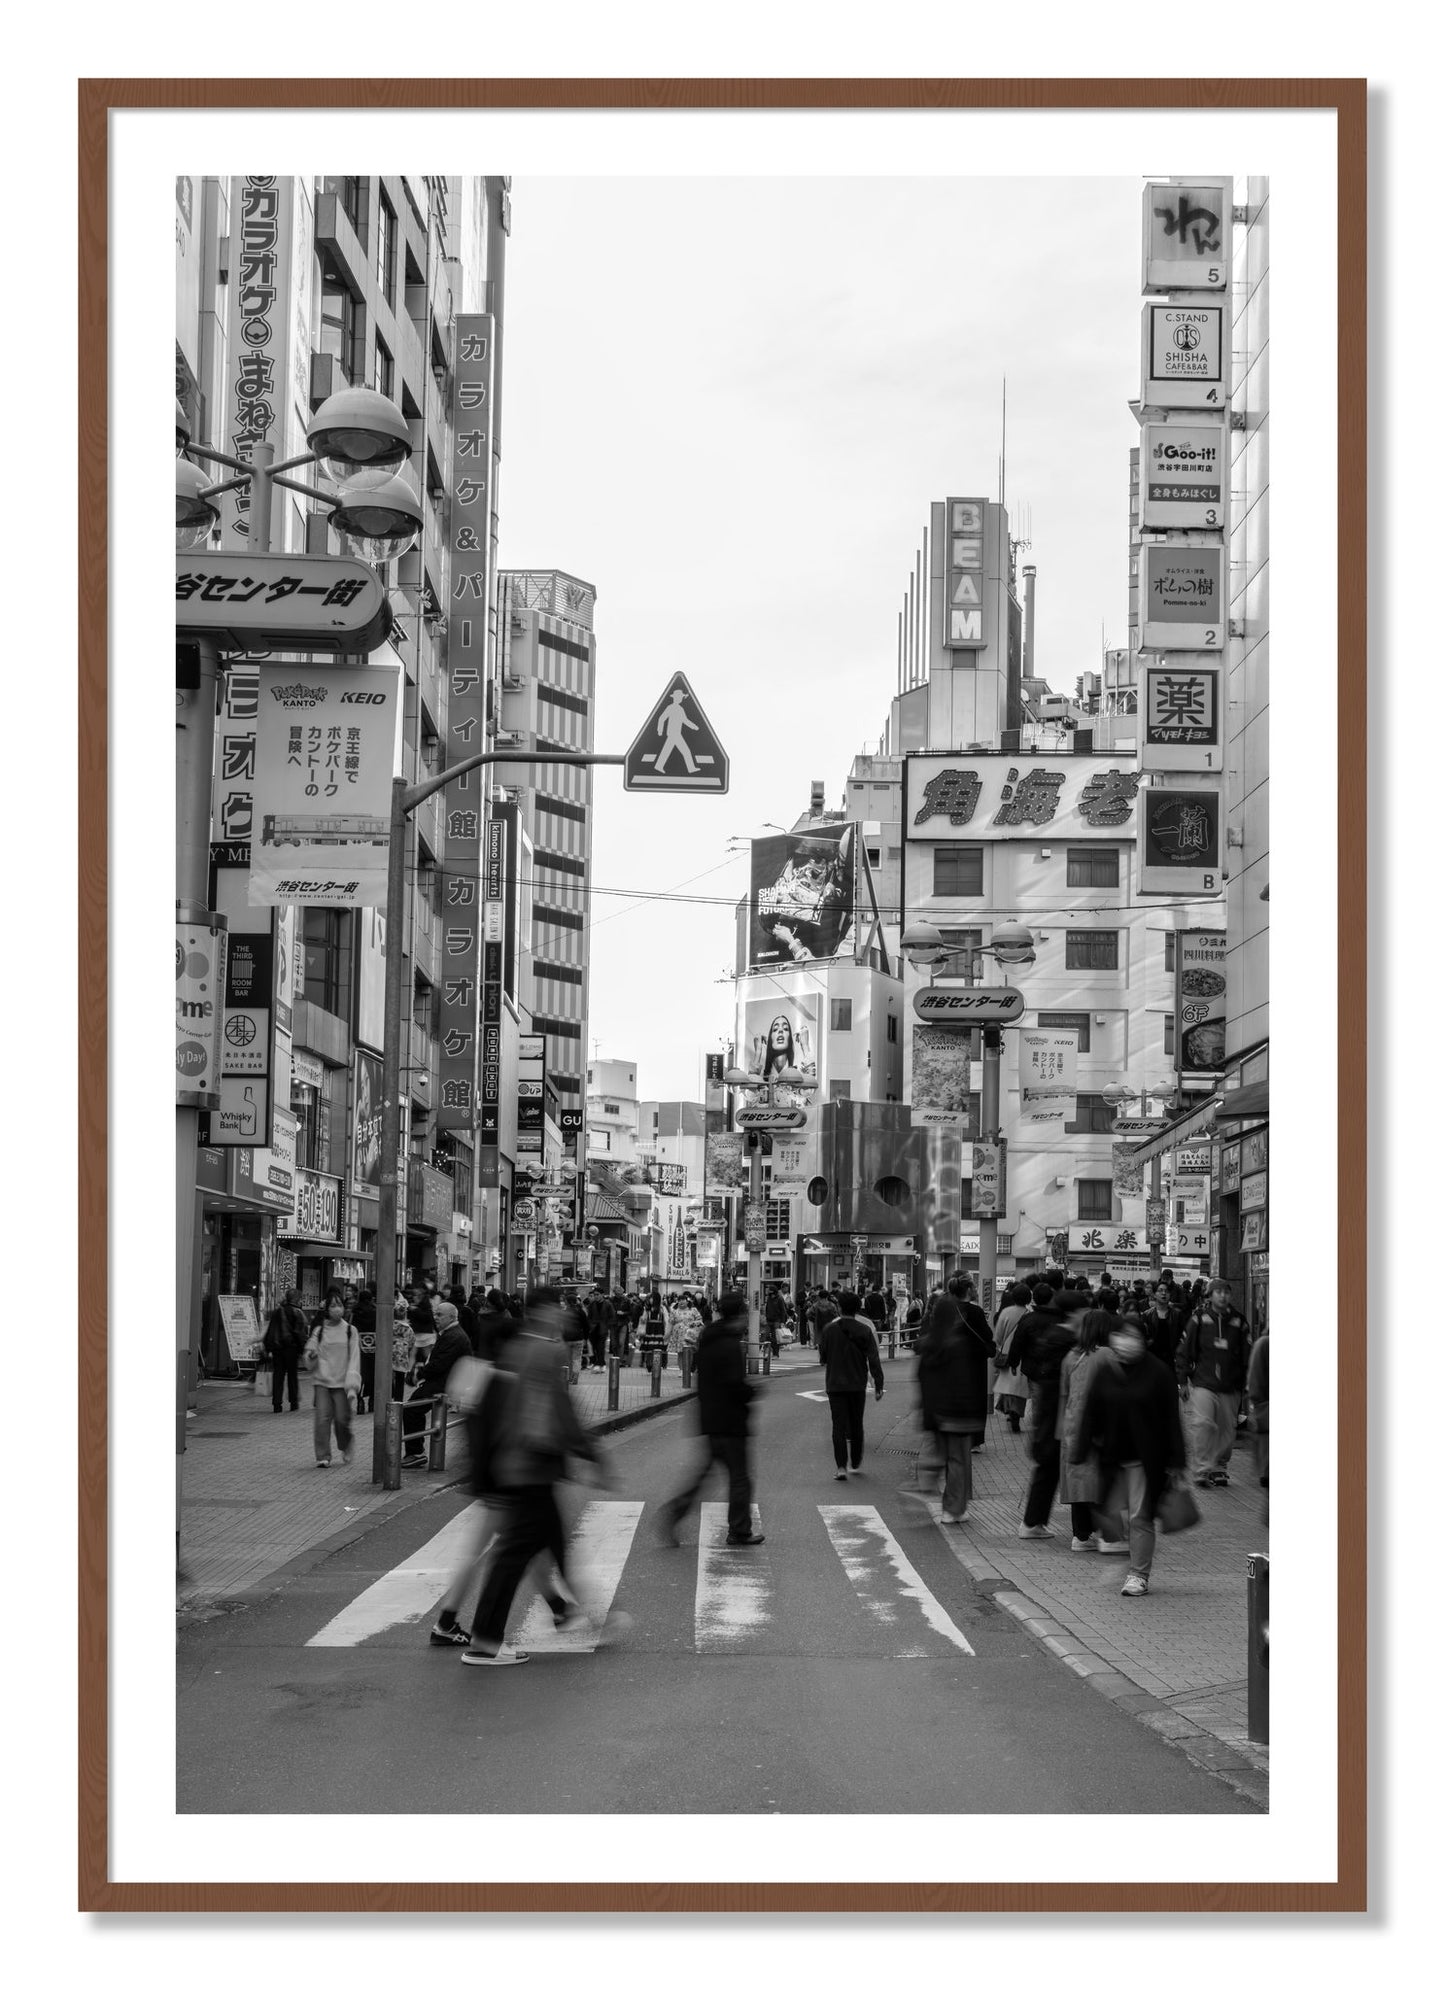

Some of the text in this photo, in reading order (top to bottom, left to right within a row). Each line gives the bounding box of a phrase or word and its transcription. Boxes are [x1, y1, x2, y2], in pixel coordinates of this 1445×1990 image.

[241, 187, 278, 317] カラオケ
[1207, 268, 1220, 283] 5
[1165, 313, 1208, 323] C.STAND
[1165, 352, 1208, 362] SHISHA
[1206, 388, 1218, 403] 4
[1164, 444, 1216, 460] Goo-it!
[1152, 488, 1217, 499] 全身もみほぐし
[1205, 509, 1218, 525] 3
[951, 502, 983, 641] BEAM
[1205, 630, 1217, 645] 2
[340, 691, 387, 705] KEIO
[1156, 676, 1205, 725] 薬
[1151, 727, 1211, 742] マツモトキヨシ
[287, 726, 303, 767] 冒険へ
[305, 726, 322, 796] カントーの
[324, 726, 342, 797] ポケパーク
[344, 726, 361, 783] 京王線で
[1204, 752, 1214, 768] 1
[1151, 805, 1209, 851] 一蘭
[489, 823, 500, 860] kimono
[274, 879, 360, 894] 渋谷センター街
[1203, 874, 1216, 890] B
[232, 952, 253, 960] THIRD
[1184, 949, 1226, 961] 四川料理
[446, 877, 475, 1109] カラオケ館
[487, 972, 499, 1018] union
[920, 995, 1018, 1009] 渋谷センター街
[1182, 1004, 1210, 1023] 6F
[186, 1050, 207, 1064] Day!
[220, 1112, 252, 1123] Whisky
[562, 1115, 582, 1126] GU
[739, 1112, 798, 1121] 渋谷センター街
[220, 1121, 238, 1129] Bank
[1114, 1121, 1169, 1130] 渋谷センター街
[1081, 1228, 1138, 1249] 兆楽
